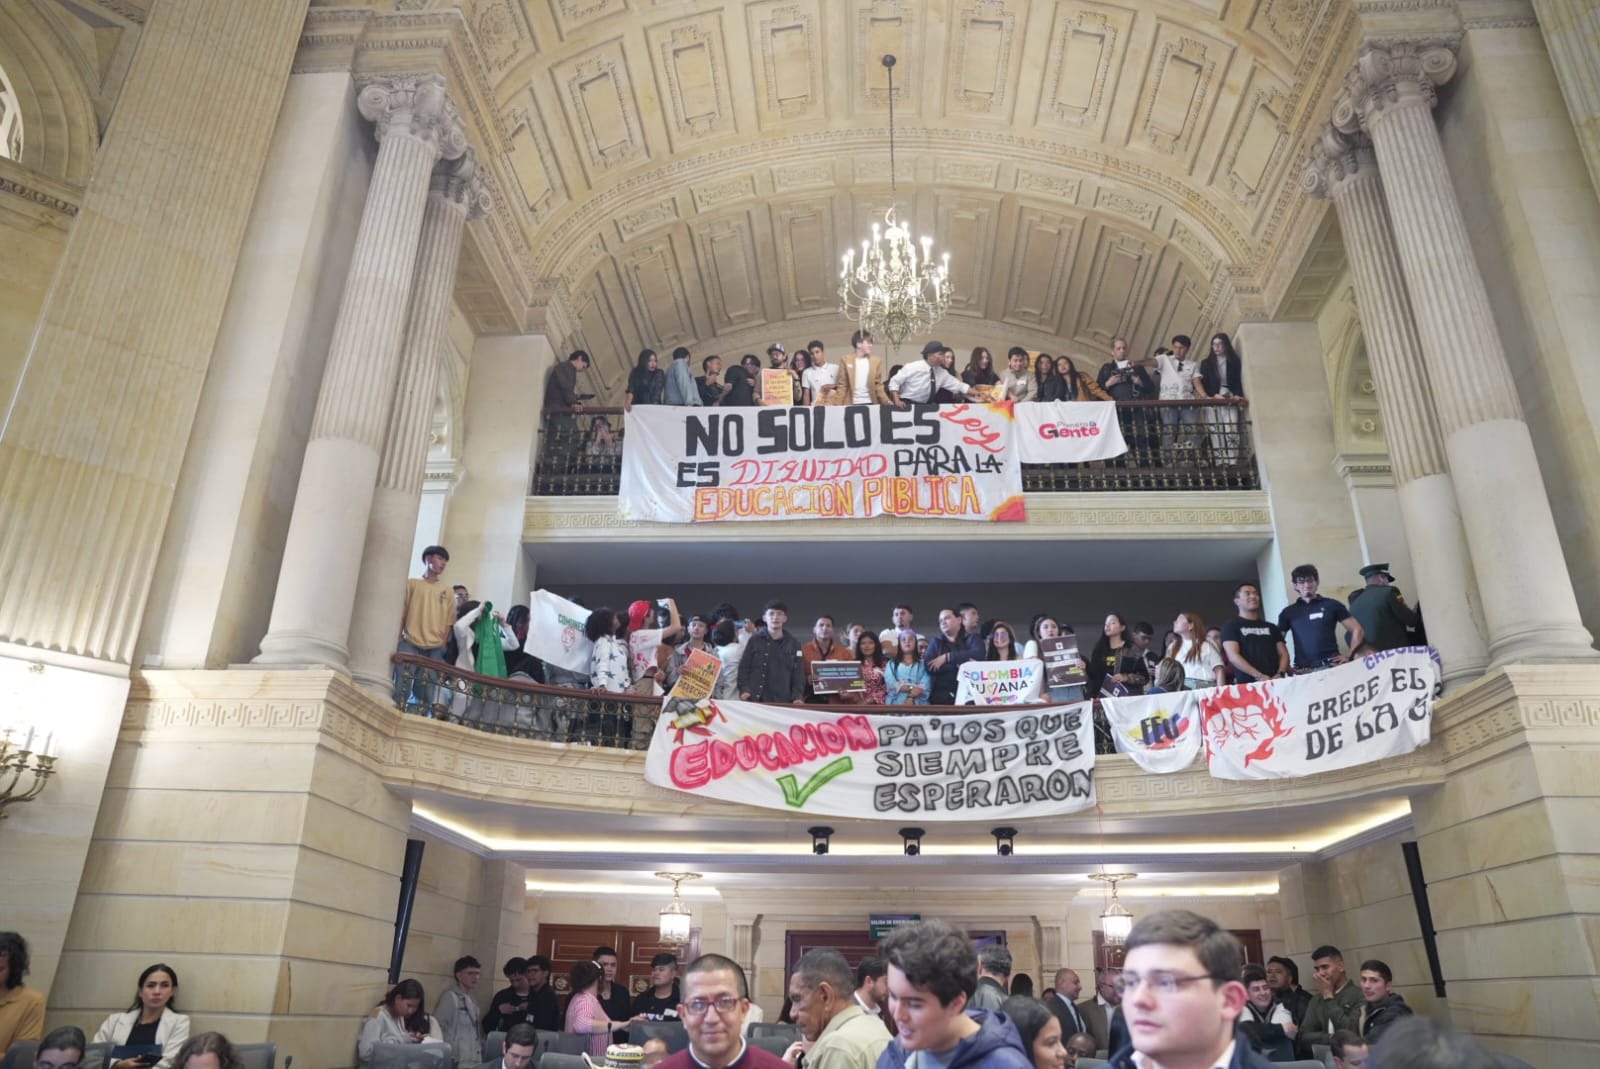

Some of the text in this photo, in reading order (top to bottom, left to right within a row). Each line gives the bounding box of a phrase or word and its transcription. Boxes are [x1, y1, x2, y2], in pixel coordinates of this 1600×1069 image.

[686, 414, 744, 456] NO
[757, 406, 872, 454] SOLO
[880, 404, 940, 445] ES
[1039, 422, 1100, 439] Gente
[677, 462, 720, 487] ES
[894, 445, 972, 477] PARA
[976, 453, 1004, 474] LA
[863, 475, 982, 516] PUBLICA
[1307, 675, 1380, 725] CRECE
[1391, 668, 1426, 692] EL
[669, 715, 878, 789] EDUCACION
[1015, 707, 1083, 740] QUE
[1305, 723, 1343, 760] DE
[1355, 702, 1399, 742] LA
[875, 733, 1084, 779] SIEMPRE
[873, 767, 1095, 812] ESPERARON
